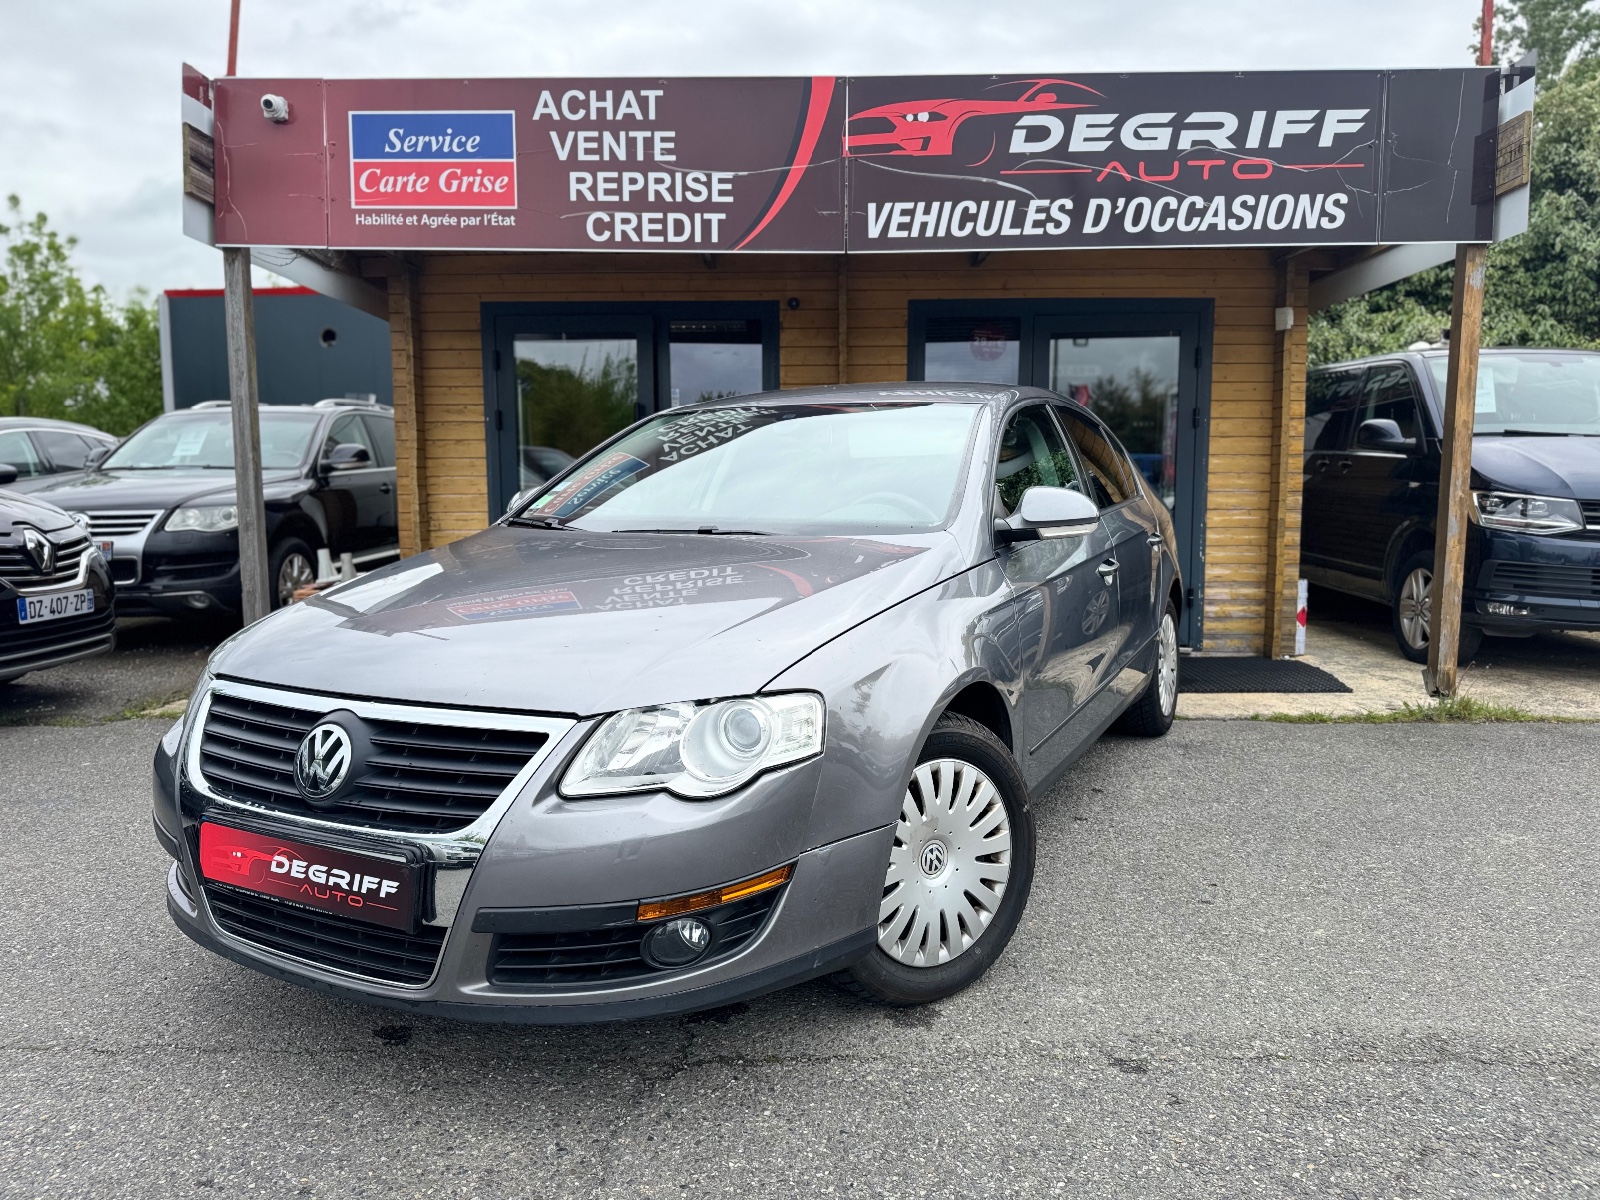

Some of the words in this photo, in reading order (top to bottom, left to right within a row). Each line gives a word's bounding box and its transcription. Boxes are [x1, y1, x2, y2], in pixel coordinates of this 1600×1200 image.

[532, 90, 664, 121] ACHAT
[384, 128, 481, 153] Service
[549, 130, 677, 161] VENTE
[1008, 108, 1371, 153] DEGRIFF
[359, 168, 430, 193] Carte
[438, 168, 509, 193] Grise
[1096, 158, 1273, 182] AUTO
[569, 171, 734, 203] REPRISE
[355, 213, 404, 226] Habilité
[405, 214, 418, 225] et
[420, 213, 458, 229] Agrée
[460, 216, 482, 228] par
[483, 212, 516, 226] l'État
[585, 211, 727, 243] CREDIT
[867, 198, 1074, 239] VEHICULES
[1082, 192, 1349, 234] D'OCCASIONS
[28, 593, 87, 619] DZ-407-ZP
[270, 855, 401, 898] DEGRIFF
[299, 883, 364, 908] AUTO
